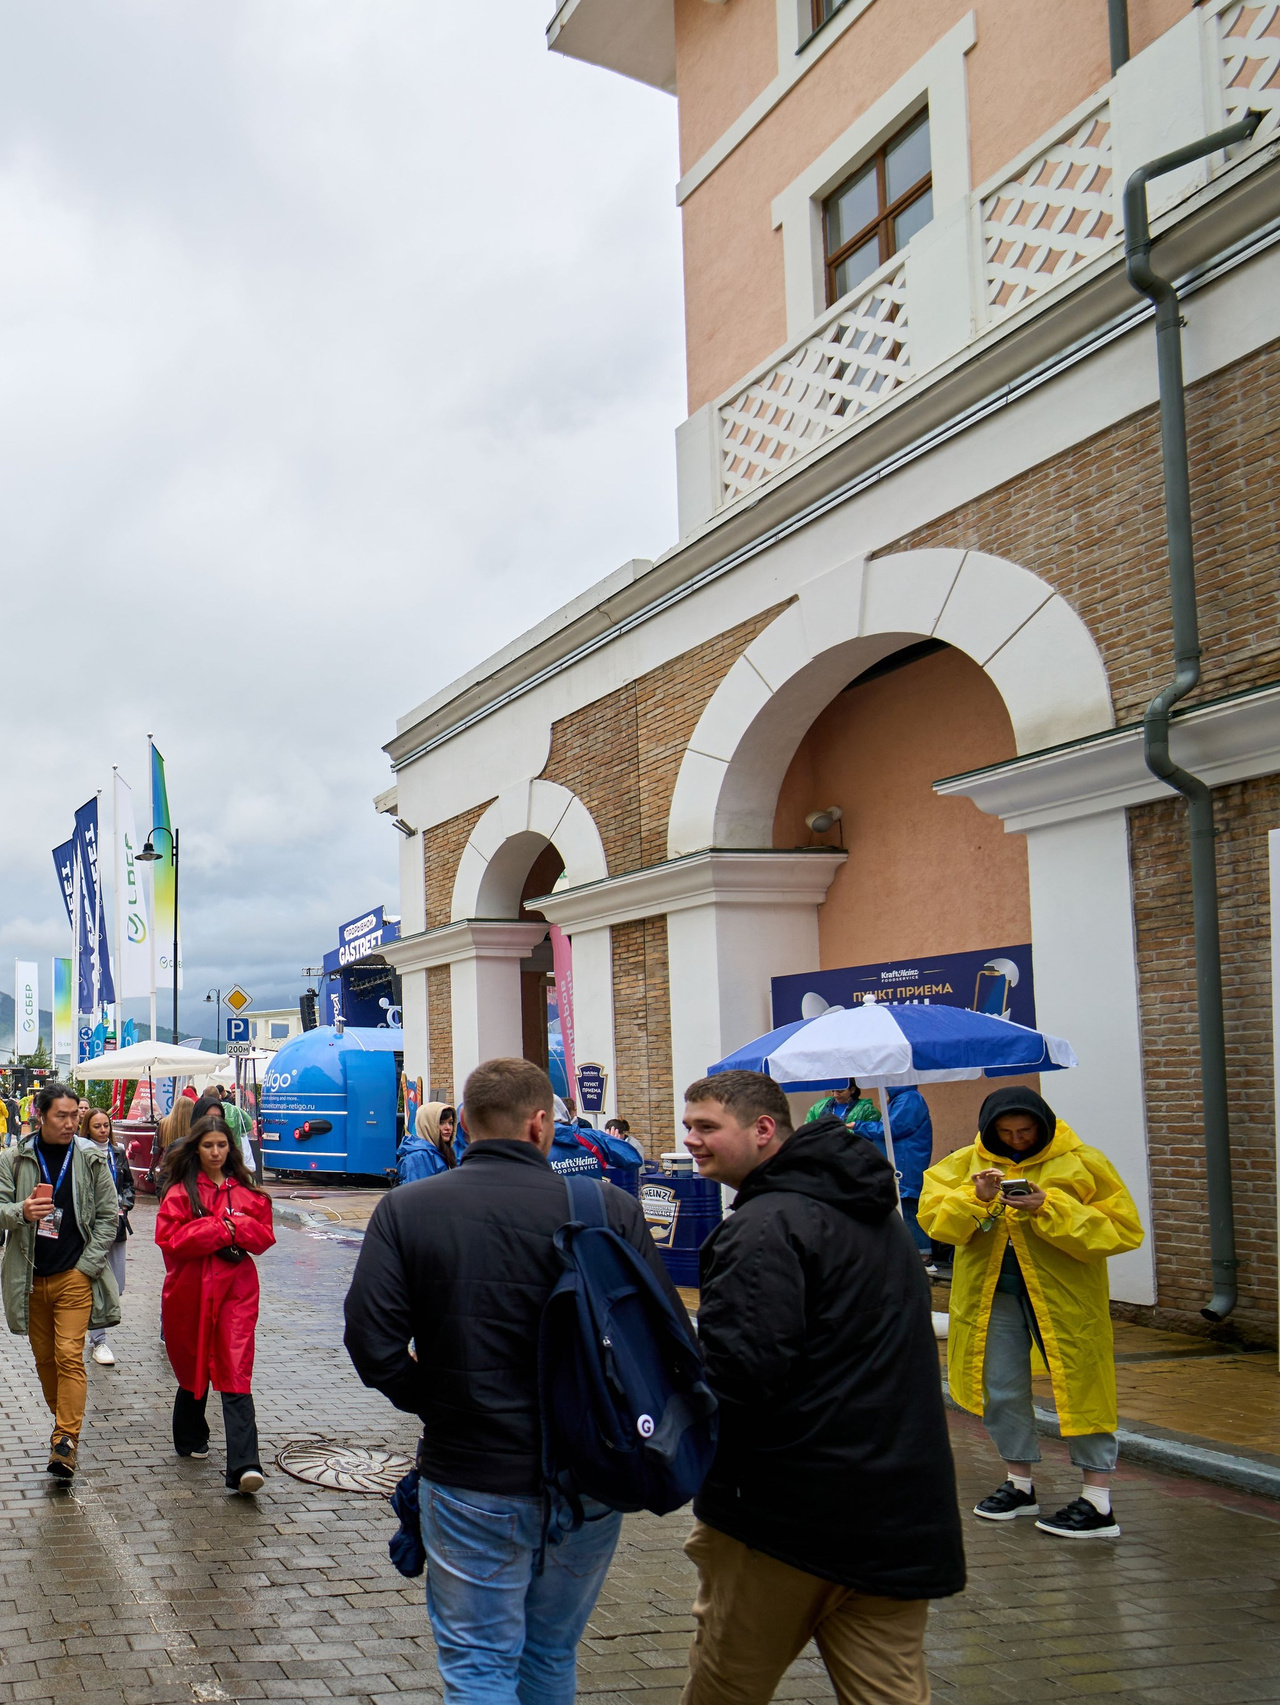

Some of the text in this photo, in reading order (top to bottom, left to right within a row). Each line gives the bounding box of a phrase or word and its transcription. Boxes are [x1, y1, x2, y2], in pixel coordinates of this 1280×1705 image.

[897, 982, 953, 999] ПРИЕМА
[25, 984, 34, 1016] СБЕР
[644, 1189, 668, 1200] HEINZ
[641, 1419, 651, 1434] G
